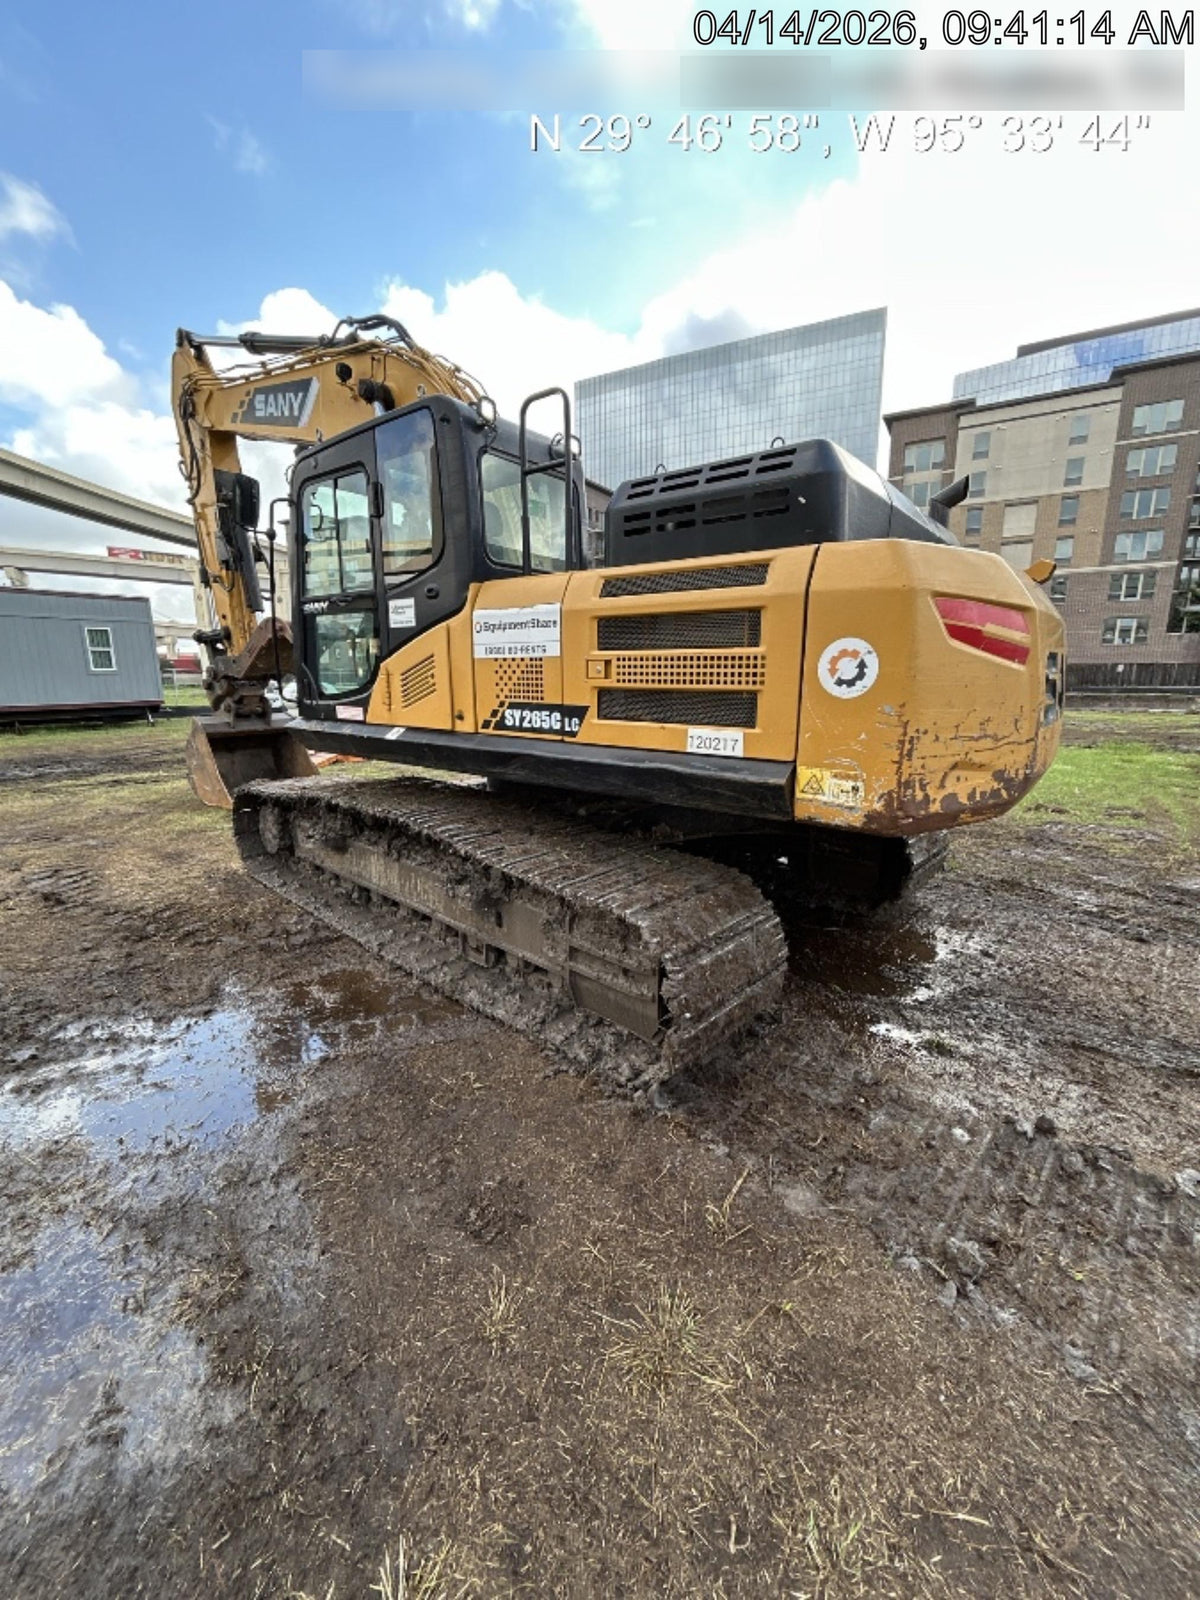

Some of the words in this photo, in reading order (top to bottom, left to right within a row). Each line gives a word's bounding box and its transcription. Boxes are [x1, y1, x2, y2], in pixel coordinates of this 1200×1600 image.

[253, 392, 304, 417] SANY
[564, 717, 581, 732] LC
[688, 734, 740, 753] 120217
